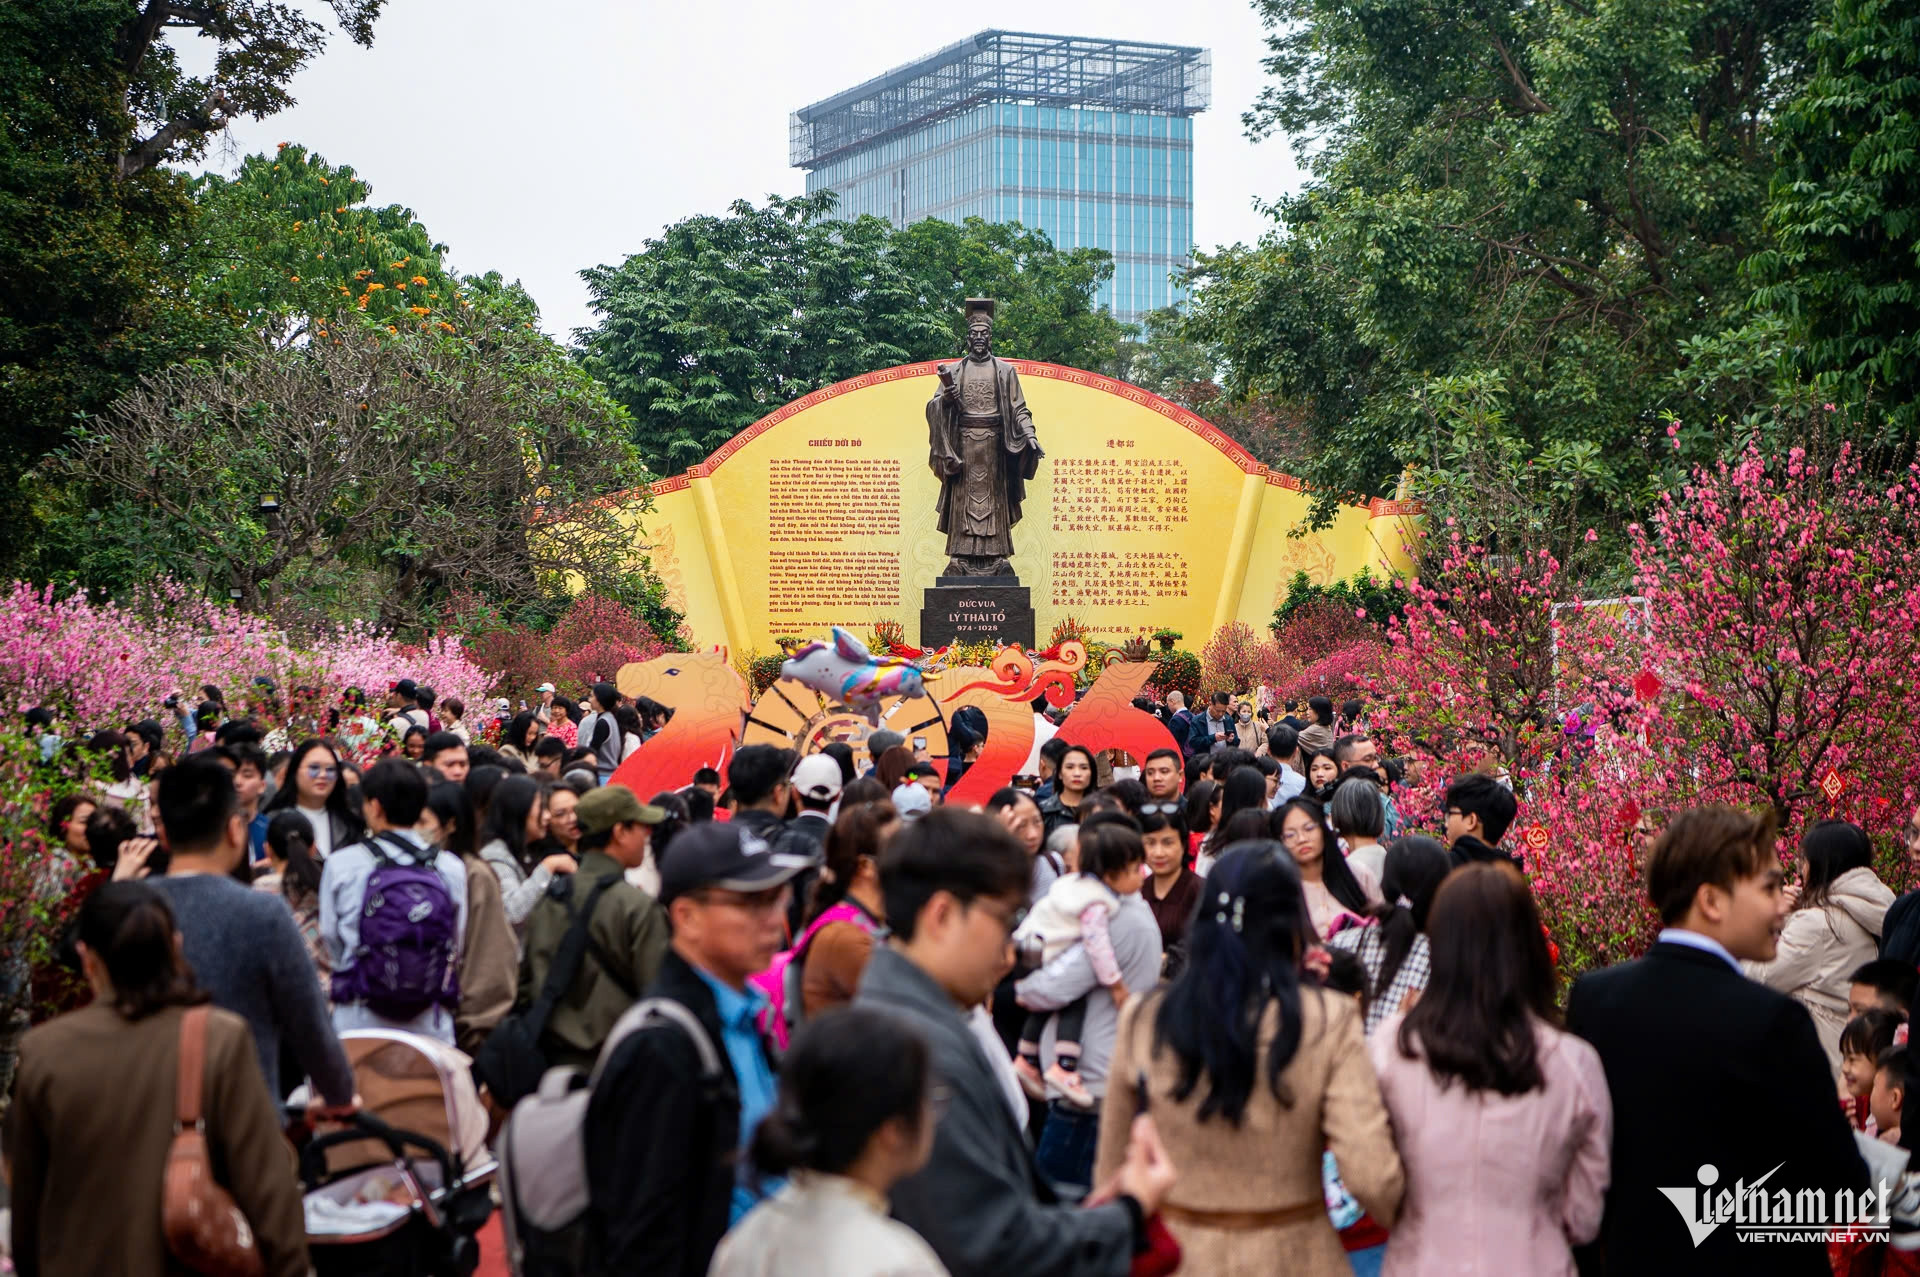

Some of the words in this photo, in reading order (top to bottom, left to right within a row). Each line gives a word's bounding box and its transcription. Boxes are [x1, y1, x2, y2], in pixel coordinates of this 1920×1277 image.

[959, 599, 977, 607] ĐỨC
[949, 612, 960, 622] LÝ
[963, 612, 988, 622] THÁI
[991, 609, 1005, 622] TỔ
